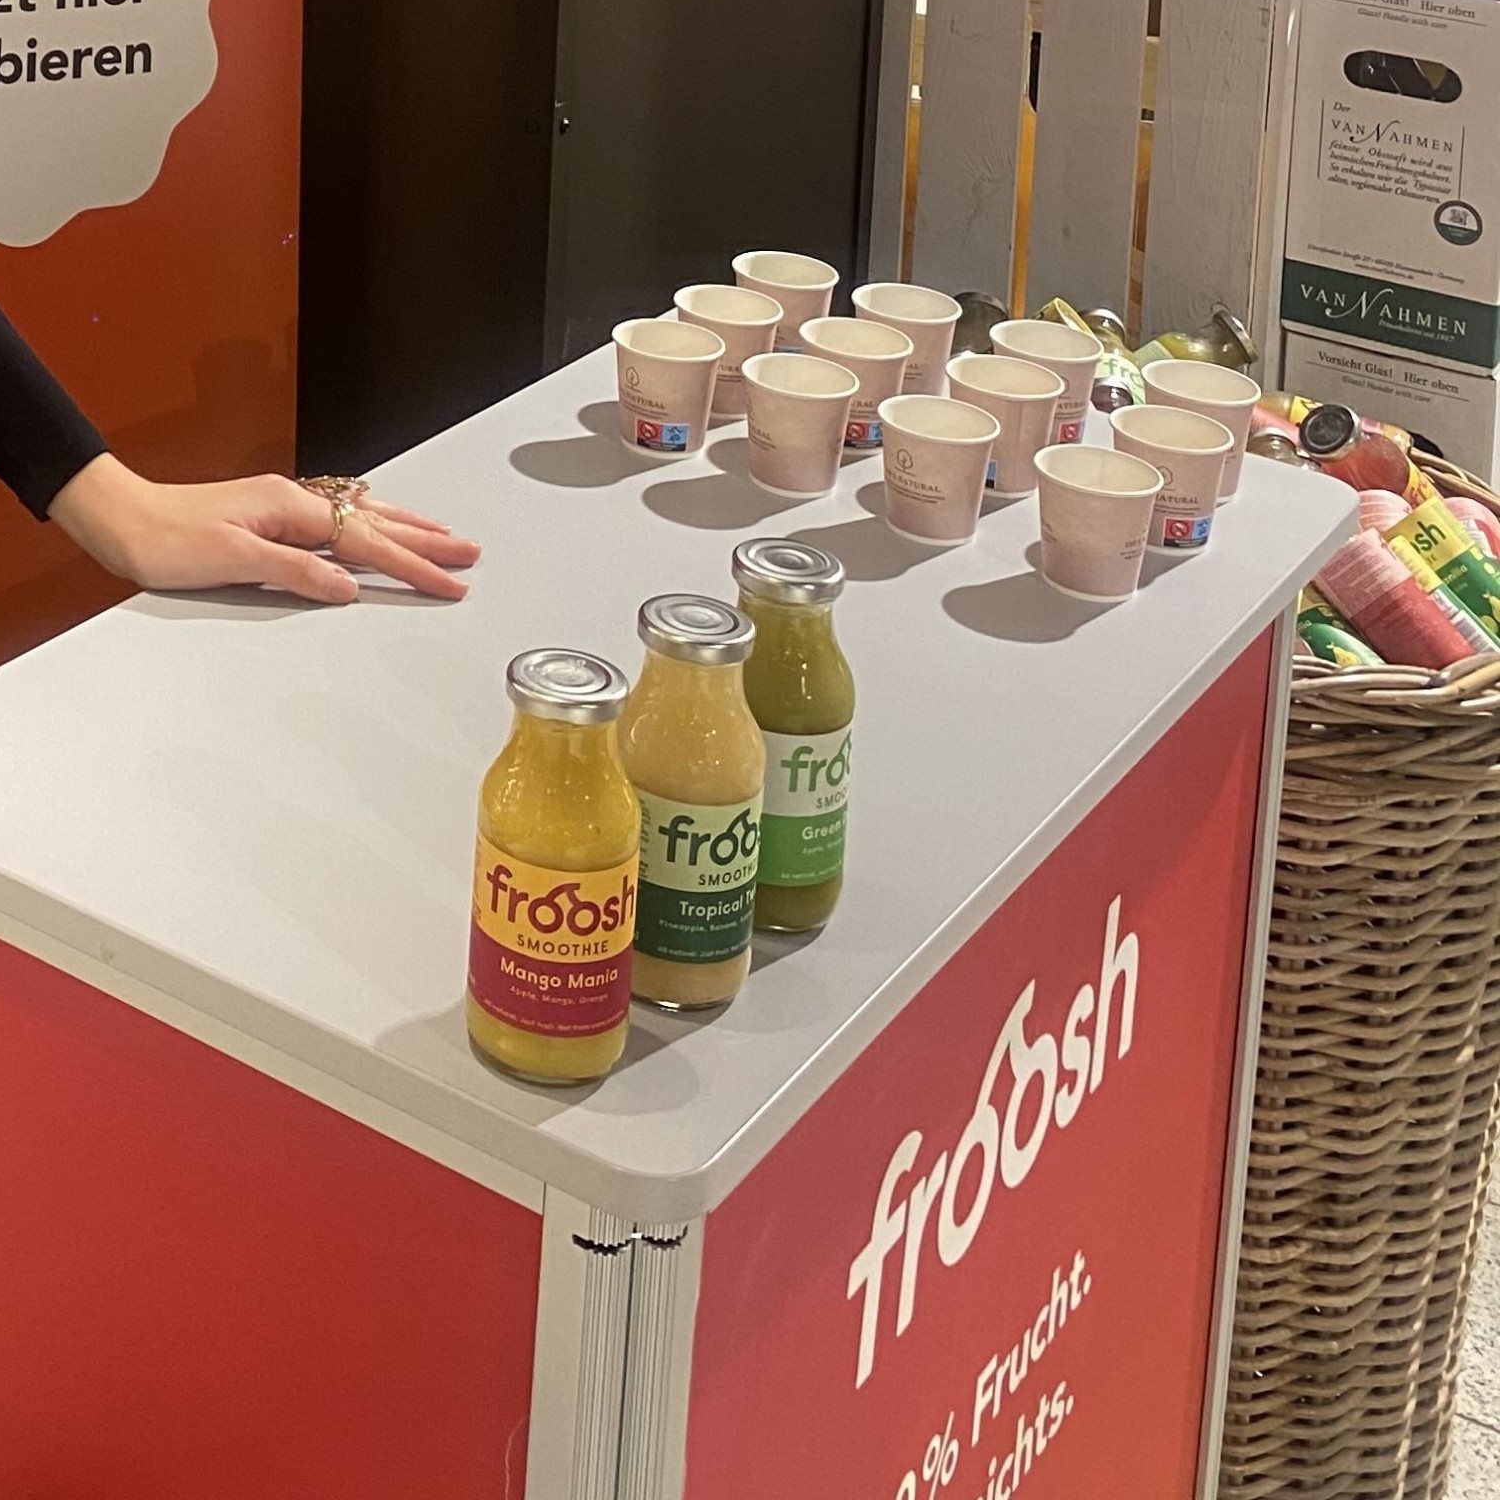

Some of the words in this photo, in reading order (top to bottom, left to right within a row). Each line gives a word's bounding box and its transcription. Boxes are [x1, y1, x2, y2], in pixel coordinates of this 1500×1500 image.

[1420, 0, 1445, 14] Hier
[1447, 4, 1476, 19] oben
[1331, 118, 1366, 136] VAN
[1349, 120, 1454, 153] NAHMEN
[1300, 283, 1347, 308] VAN
[1324, 288, 1467, 336] NAHMEN
[1318, 351, 1362, 371] Vorsicht
[1365, 362, 1393, 378] Glas!
[1404, 371, 1429, 387] Hier
[1431, 379, 1460, 394] oben
[658, 807, 761, 867] froo
[802, 820, 842, 841] Green
[486, 863, 635, 936] froosh
[679, 894, 744, 922] Tropical
[517, 933, 609, 957] SMOOTHIE
[500, 957, 562, 991] Mango
[568, 966, 619, 989] Mania
[846, 893, 1140, 1389] froosh
[971, 1249, 1092, 1448] Frucht.
[977, 1380, 1075, 1500] ichts.
